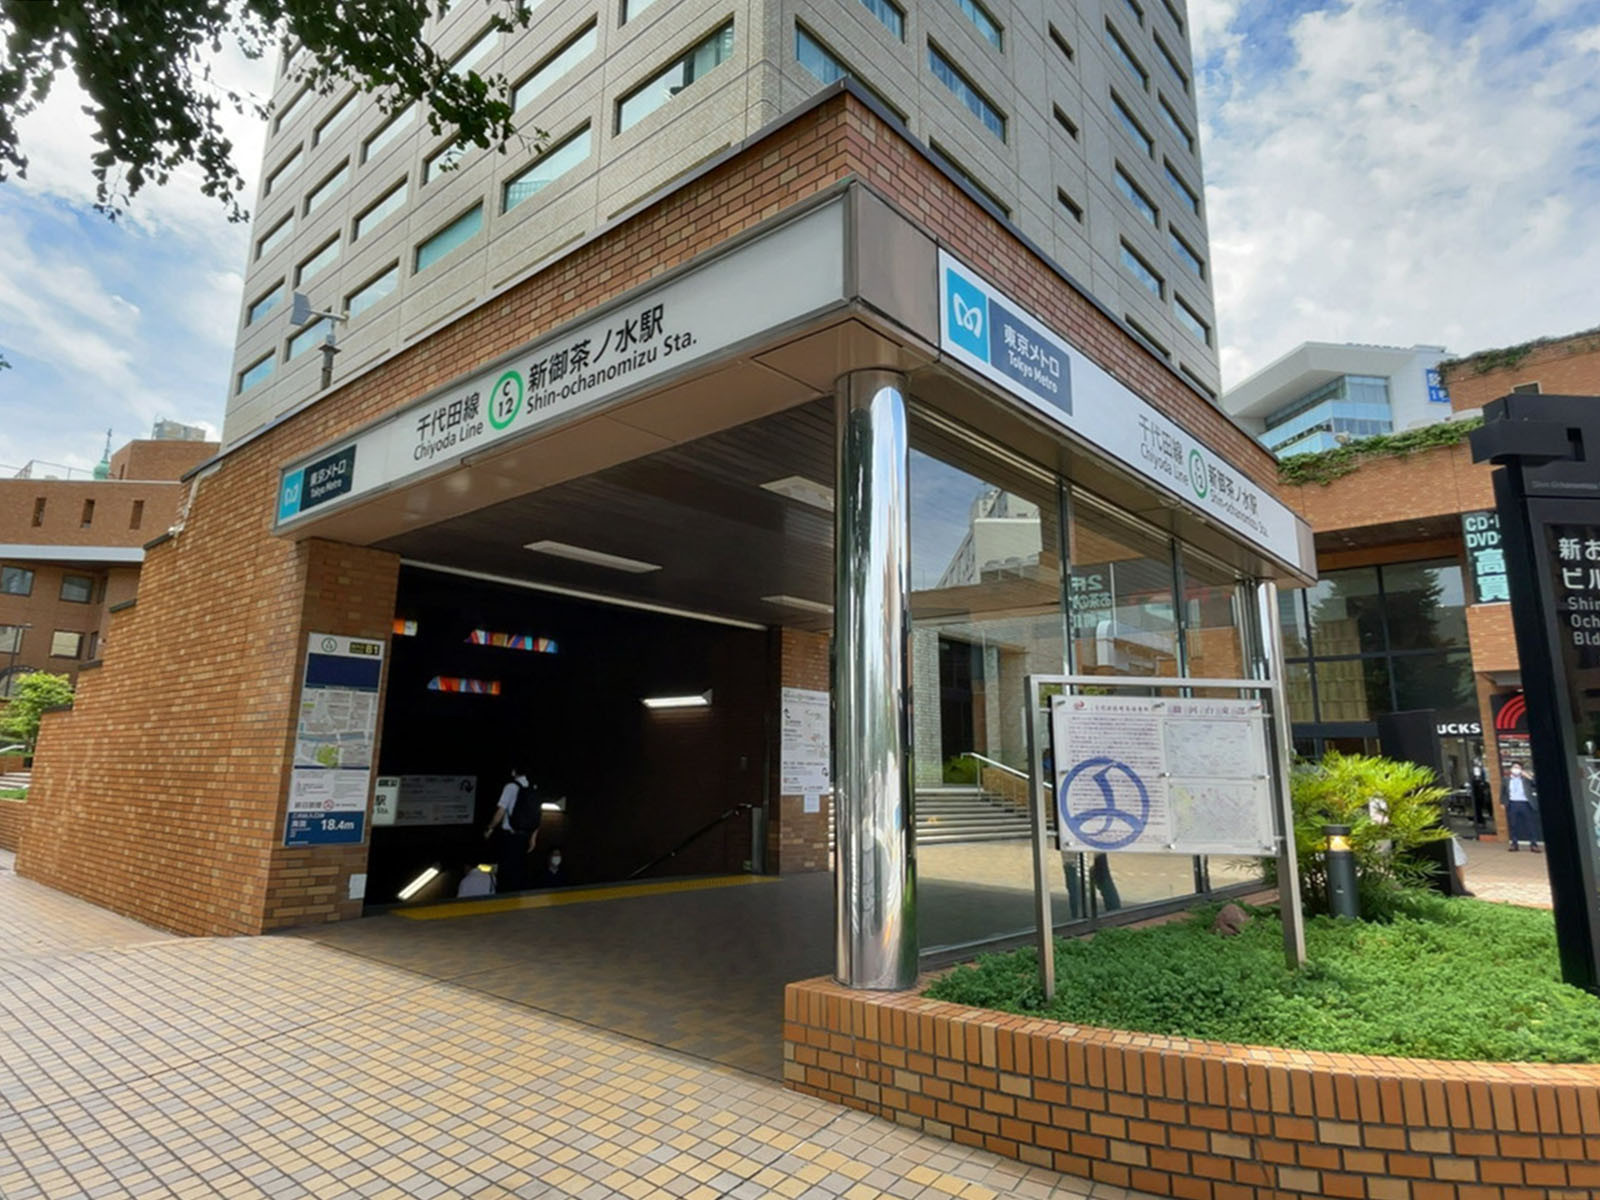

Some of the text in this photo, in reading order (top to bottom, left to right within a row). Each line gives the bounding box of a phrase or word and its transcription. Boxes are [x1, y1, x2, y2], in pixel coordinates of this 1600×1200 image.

[527, 303, 664, 393] 新御茶ノ水駅
[1003, 323, 1060, 378] 東京メトロ
[502, 381, 511, 397] C
[526, 331, 697, 415] Shin-ochanomizu Sta.
[1008, 349, 1058, 393] Tokyo Metro
[417, 391, 480, 441] 千代田線
[498, 397, 514, 418] 12
[413, 421, 484, 461] Chiyoda Line
[320, 818, 354, 832] 18.4m
